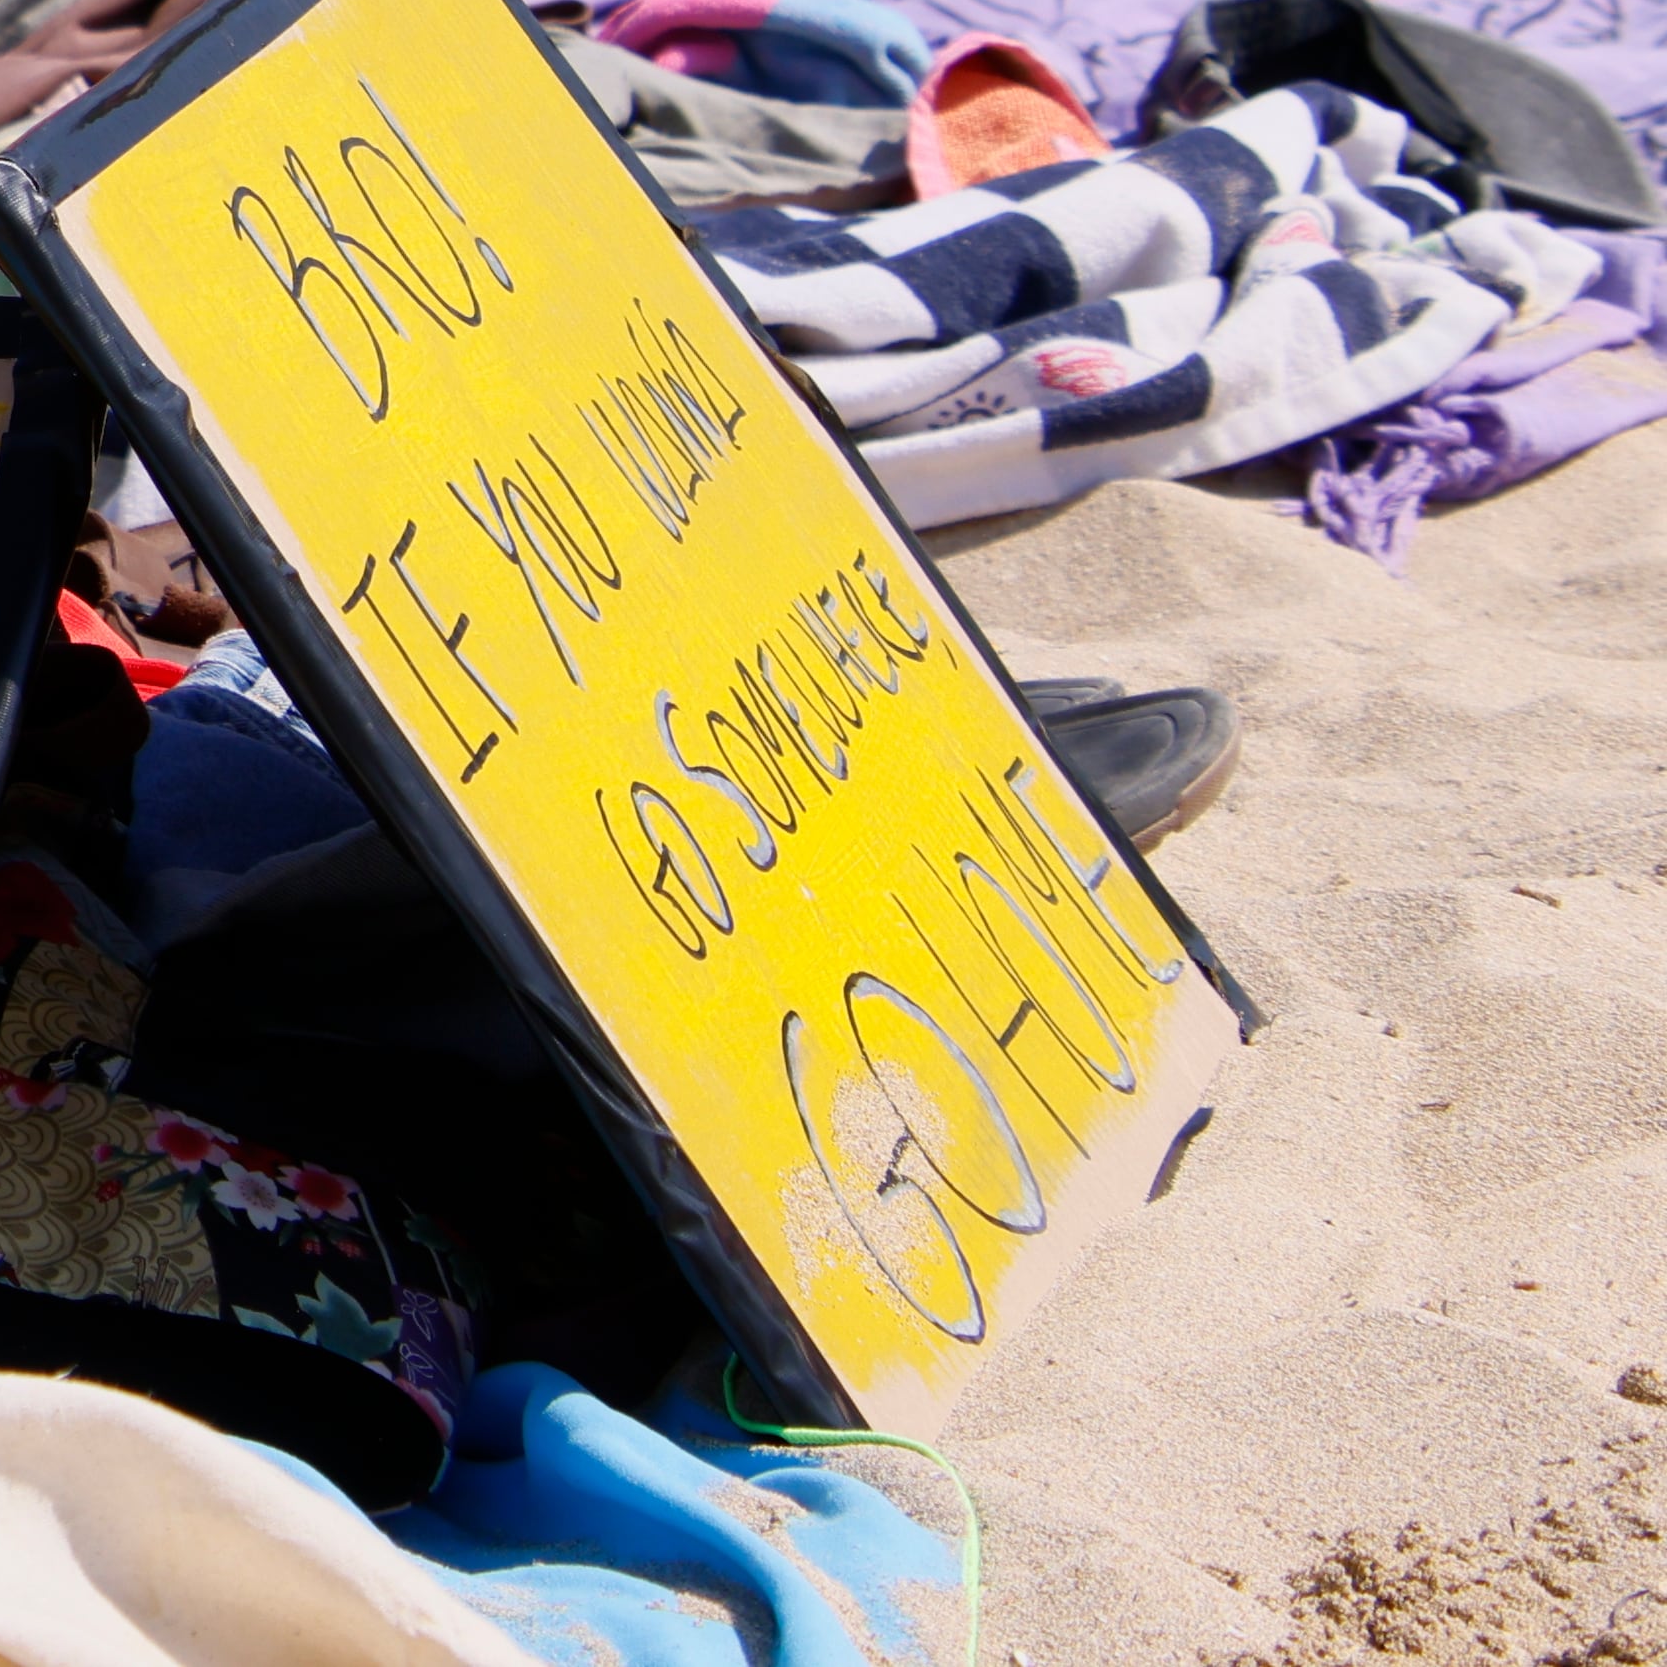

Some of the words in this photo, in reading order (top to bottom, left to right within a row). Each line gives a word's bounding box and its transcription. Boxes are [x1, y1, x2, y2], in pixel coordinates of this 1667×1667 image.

[223, 73, 514, 422] BRO!
[341, 519, 519, 783] IF
[446, 433, 621, 690] YOU
[595, 780, 734, 961] GO
[890, 756, 1186, 1161] HOME
[782, 971, 1047, 1345] GO
